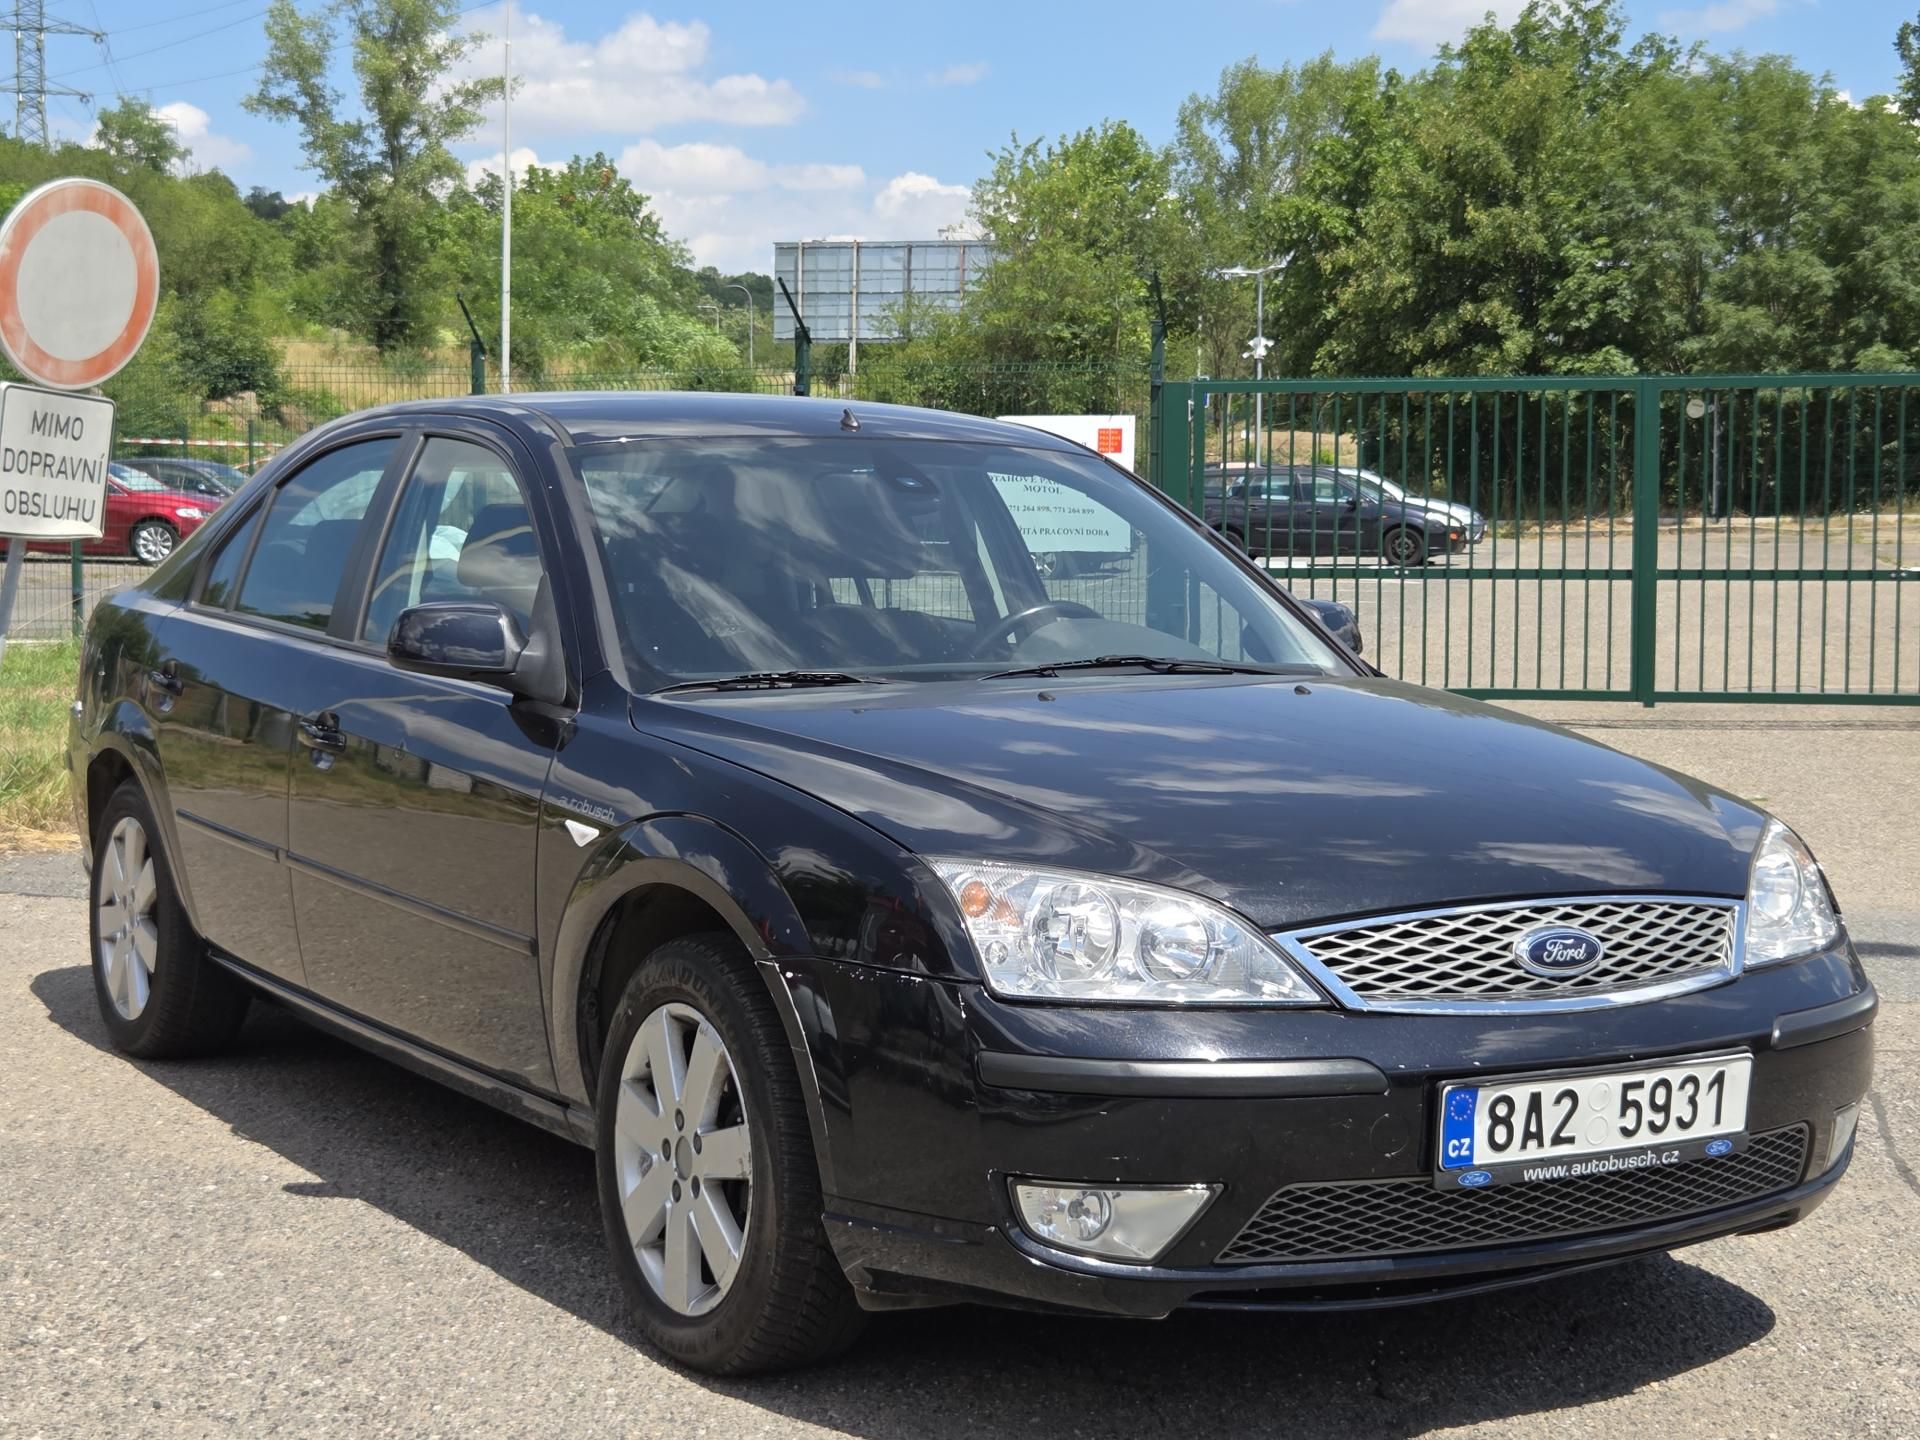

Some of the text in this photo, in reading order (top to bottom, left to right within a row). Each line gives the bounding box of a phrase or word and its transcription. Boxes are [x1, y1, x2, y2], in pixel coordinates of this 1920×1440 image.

[31, 410, 84, 441] MIMO
[3, 448, 106, 485] DOPRAVNÍ
[1023, 484, 1063, 495] MOTOL
[4, 489, 96, 523] OBSLUHU
[1022, 504, 1035, 512] 264
[1052, 506, 1066, 514] 771
[1039, 525, 1084, 536] PRACOVNÍ
[1085, 528, 1110, 537] DOBA
[1543, 938, 1587, 963] Ford
[1487, 1069, 1727, 1153] 8A2 5931
[1448, 1137, 1471, 1158] CZ
[1523, 1150, 1680, 1182] www.autobusch.cz
